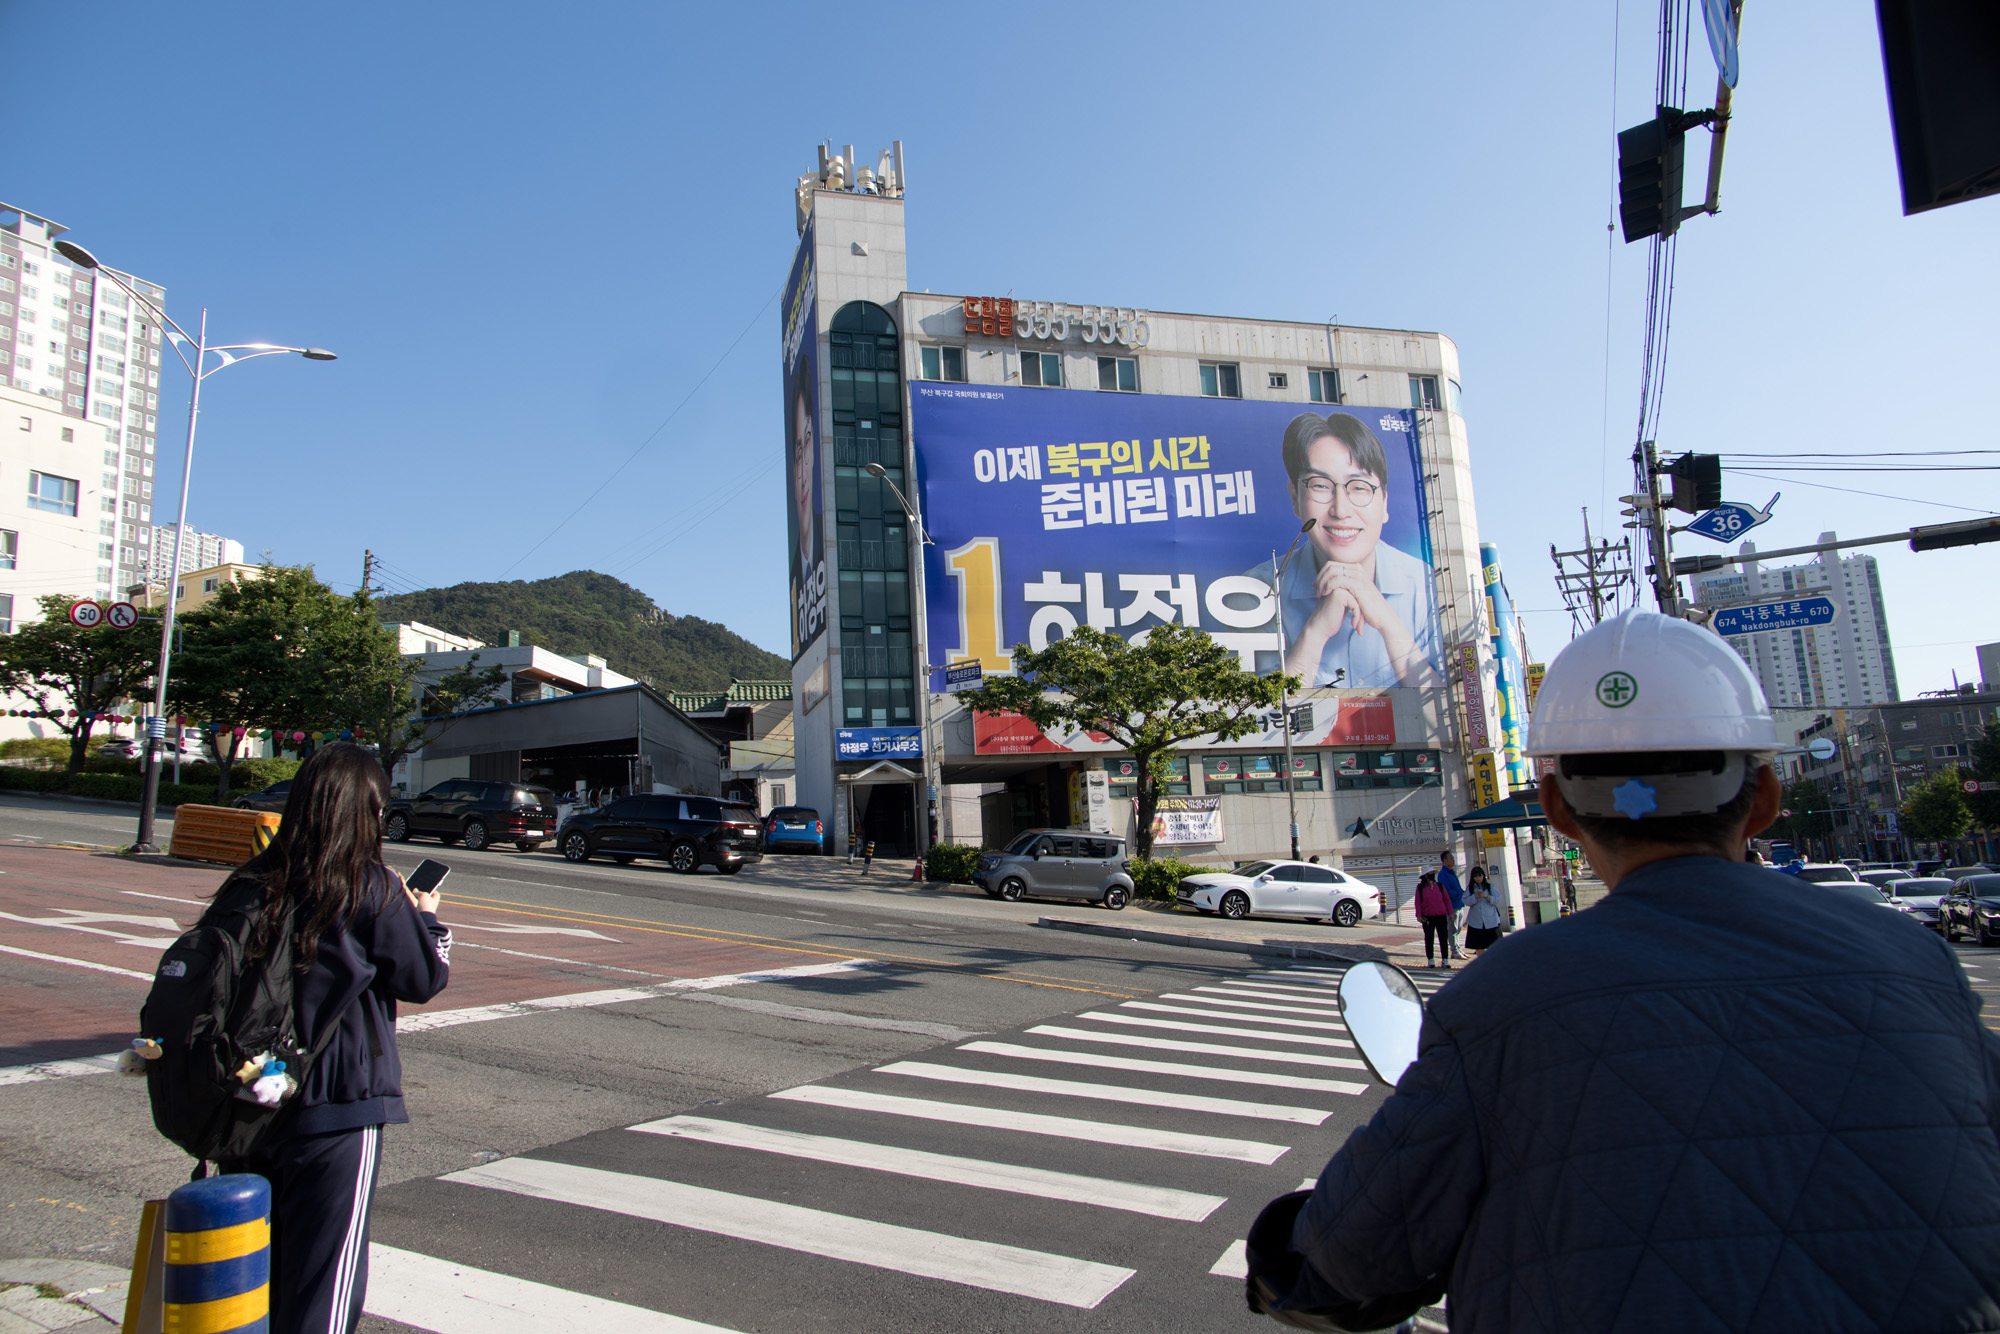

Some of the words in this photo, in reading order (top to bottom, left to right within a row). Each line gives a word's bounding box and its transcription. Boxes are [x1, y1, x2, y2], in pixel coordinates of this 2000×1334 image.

[1016, 299, 1150, 346] 555-5555
[920, 388, 934, 397] 부산
[934, 389, 953, 398] 북구갑
[954, 390, 979, 399] 국회의원
[979, 392, 1004, 400] 보궐선거
[1380, 419, 1411, 432] 민주당
[973, 446, 1042, 483] 이제
[1046, 440, 1143, 478] 북구의
[1149, 435, 1211, 471] 시간
[1041, 477, 1169, 530] 준비된
[1174, 470, 1256, 518] 미래
[1711, 514, 1742, 532] 36
[79, 607, 96, 620] 50
[798, 560, 826, 643] 하정우
[945, 536, 1017, 679] 1
[1023, 571, 1286, 674] 하정우
[1718, 618, 1737, 627] 674
[1741, 602, 1803, 621] 낙동북로
[1809, 606, 1830, 616] 670
[1741, 618, 1809, 631] Nakdongbuk-ro
[1466, 674, 1485, 735] 노래연습장
[840, 742, 869, 753] 하정우
[872, 741, 920, 753] 선거사무소
[1966, 782, 1976, 790] 50
